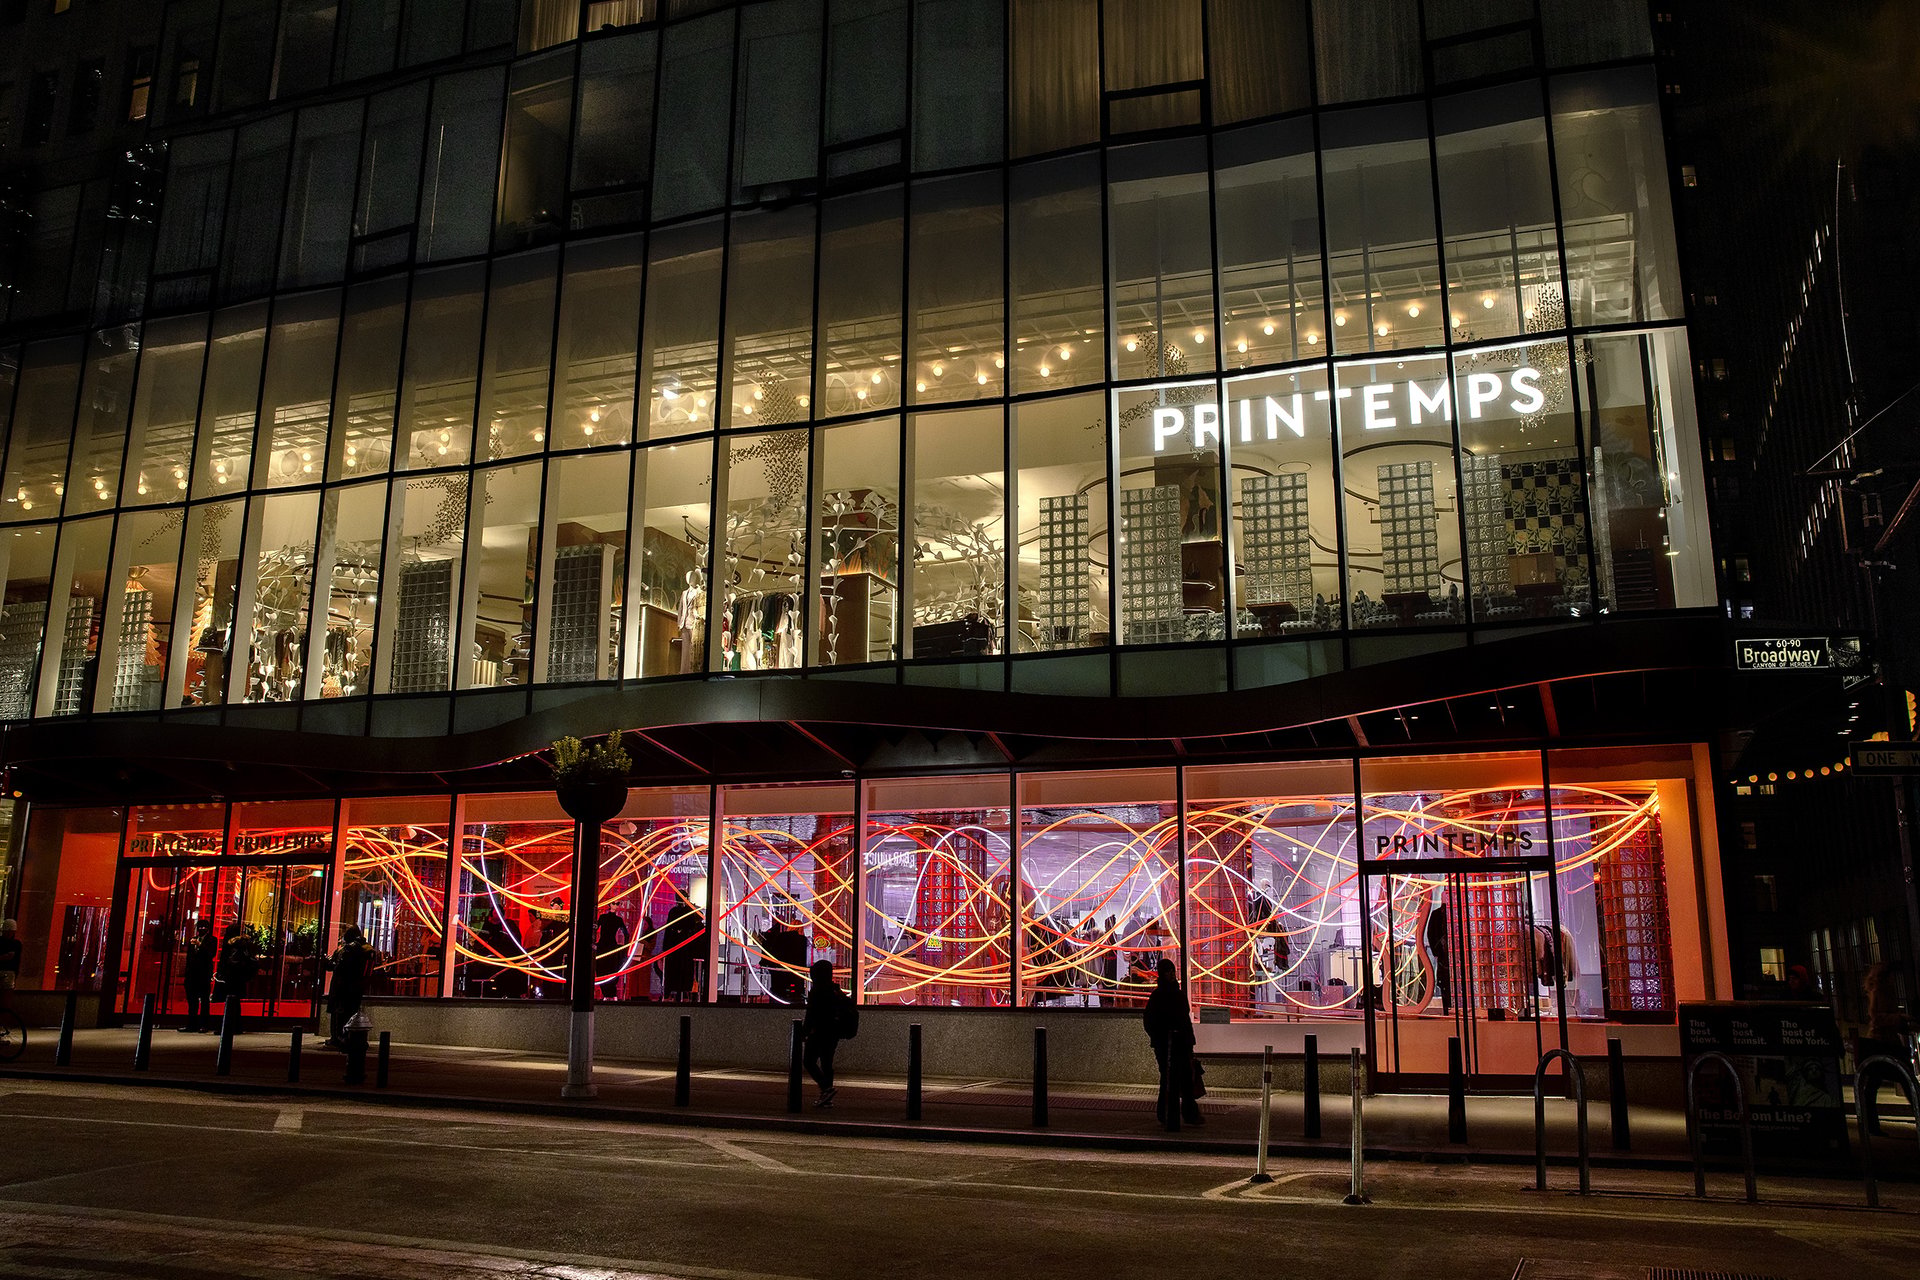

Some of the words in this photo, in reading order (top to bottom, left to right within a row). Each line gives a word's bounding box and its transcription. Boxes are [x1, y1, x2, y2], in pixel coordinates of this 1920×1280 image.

[1153, 366, 1546, 452] PRINTEMPS
[1776, 639, 1801, 648] 60-90
[1743, 647, 1821, 666] Broadway
[1866, 752, 1898, 766] ONE
[129, 835, 217, 853] PRINTEMPS
[233, 833, 326, 850] PRINTEMPS
[1376, 831, 1533, 854] PRINTEMPS
[1688, 1019, 1707, 1028] The
[1732, 1020, 1749, 1028] The
[1780, 1020, 1798, 1028] The
[1781, 1028, 1803, 1037] best
[1805, 1028, 1816, 1037] of
[1782, 1036, 1801, 1046] New
[1804, 1036, 1830, 1046] York.
[1699, 1108, 1721, 1121] The
[1723, 1109, 1772, 1122] Boom
[1774, 1110, 1813, 1124] Line?
